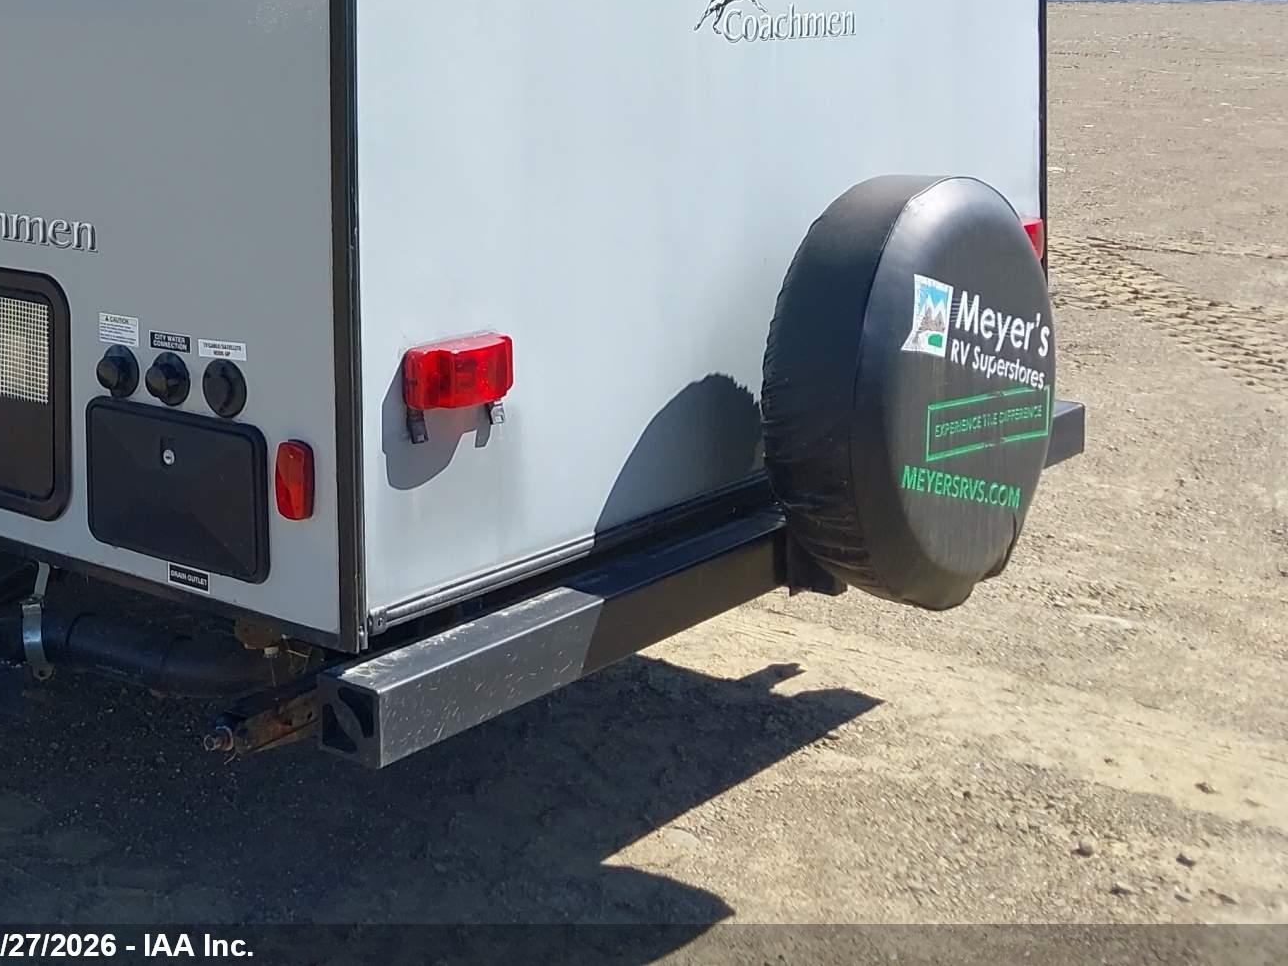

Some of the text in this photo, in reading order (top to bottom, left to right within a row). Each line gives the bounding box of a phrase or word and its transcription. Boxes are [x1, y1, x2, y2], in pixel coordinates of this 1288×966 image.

[723, 2, 856, 43] Coachmen
[154, 333, 186, 344] CITY WATER
[955, 290, 1050, 357] Meyer's
[153, 339, 188, 351] CONNECTION
[950, 338, 1046, 390] RV Superstores
[935, 414, 982, 438] EXPERIENCE
[901, 465, 1021, 508] MEYERSRVS.COM
[187, 573, 208, 586] OUTLET
